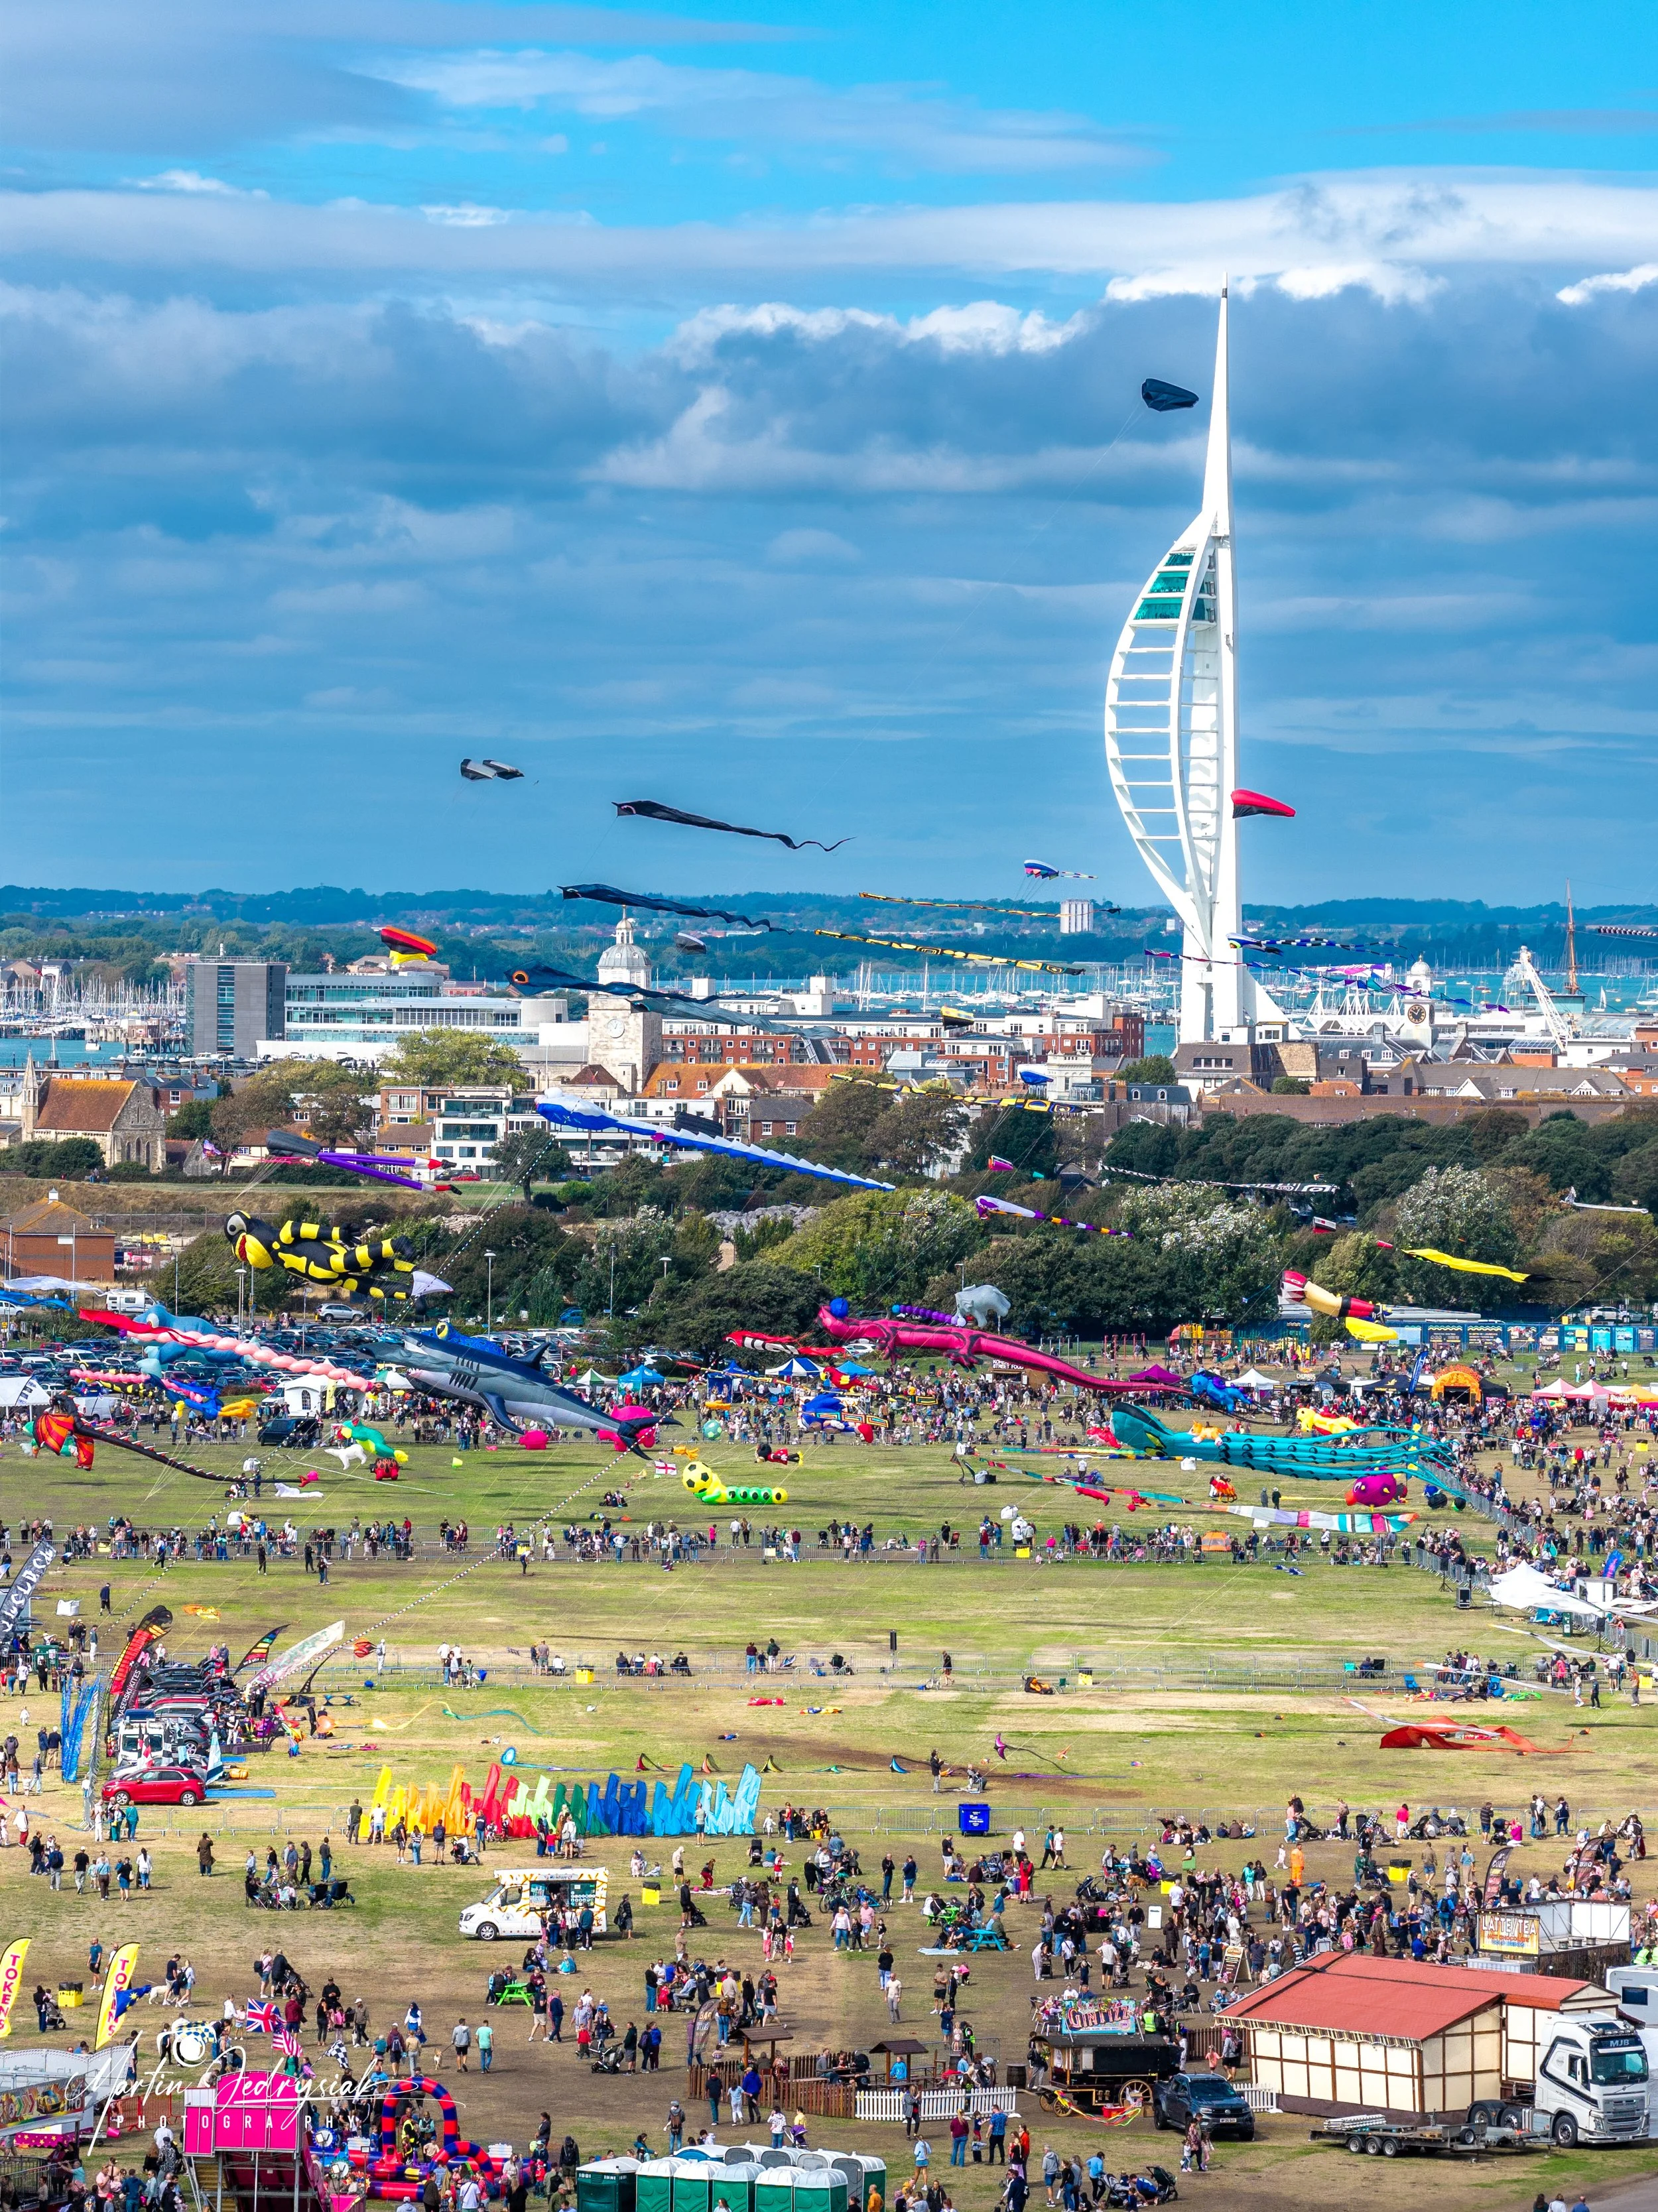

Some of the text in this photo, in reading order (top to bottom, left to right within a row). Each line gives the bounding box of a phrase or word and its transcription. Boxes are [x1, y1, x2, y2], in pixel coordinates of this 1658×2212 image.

[131, 1669, 141, 1688] KITES
[1482, 1916, 1537, 1935] LATTE/TEA
[699, 2010, 712, 2021] BAR
[1610, 2039, 1629, 2048] MJB
